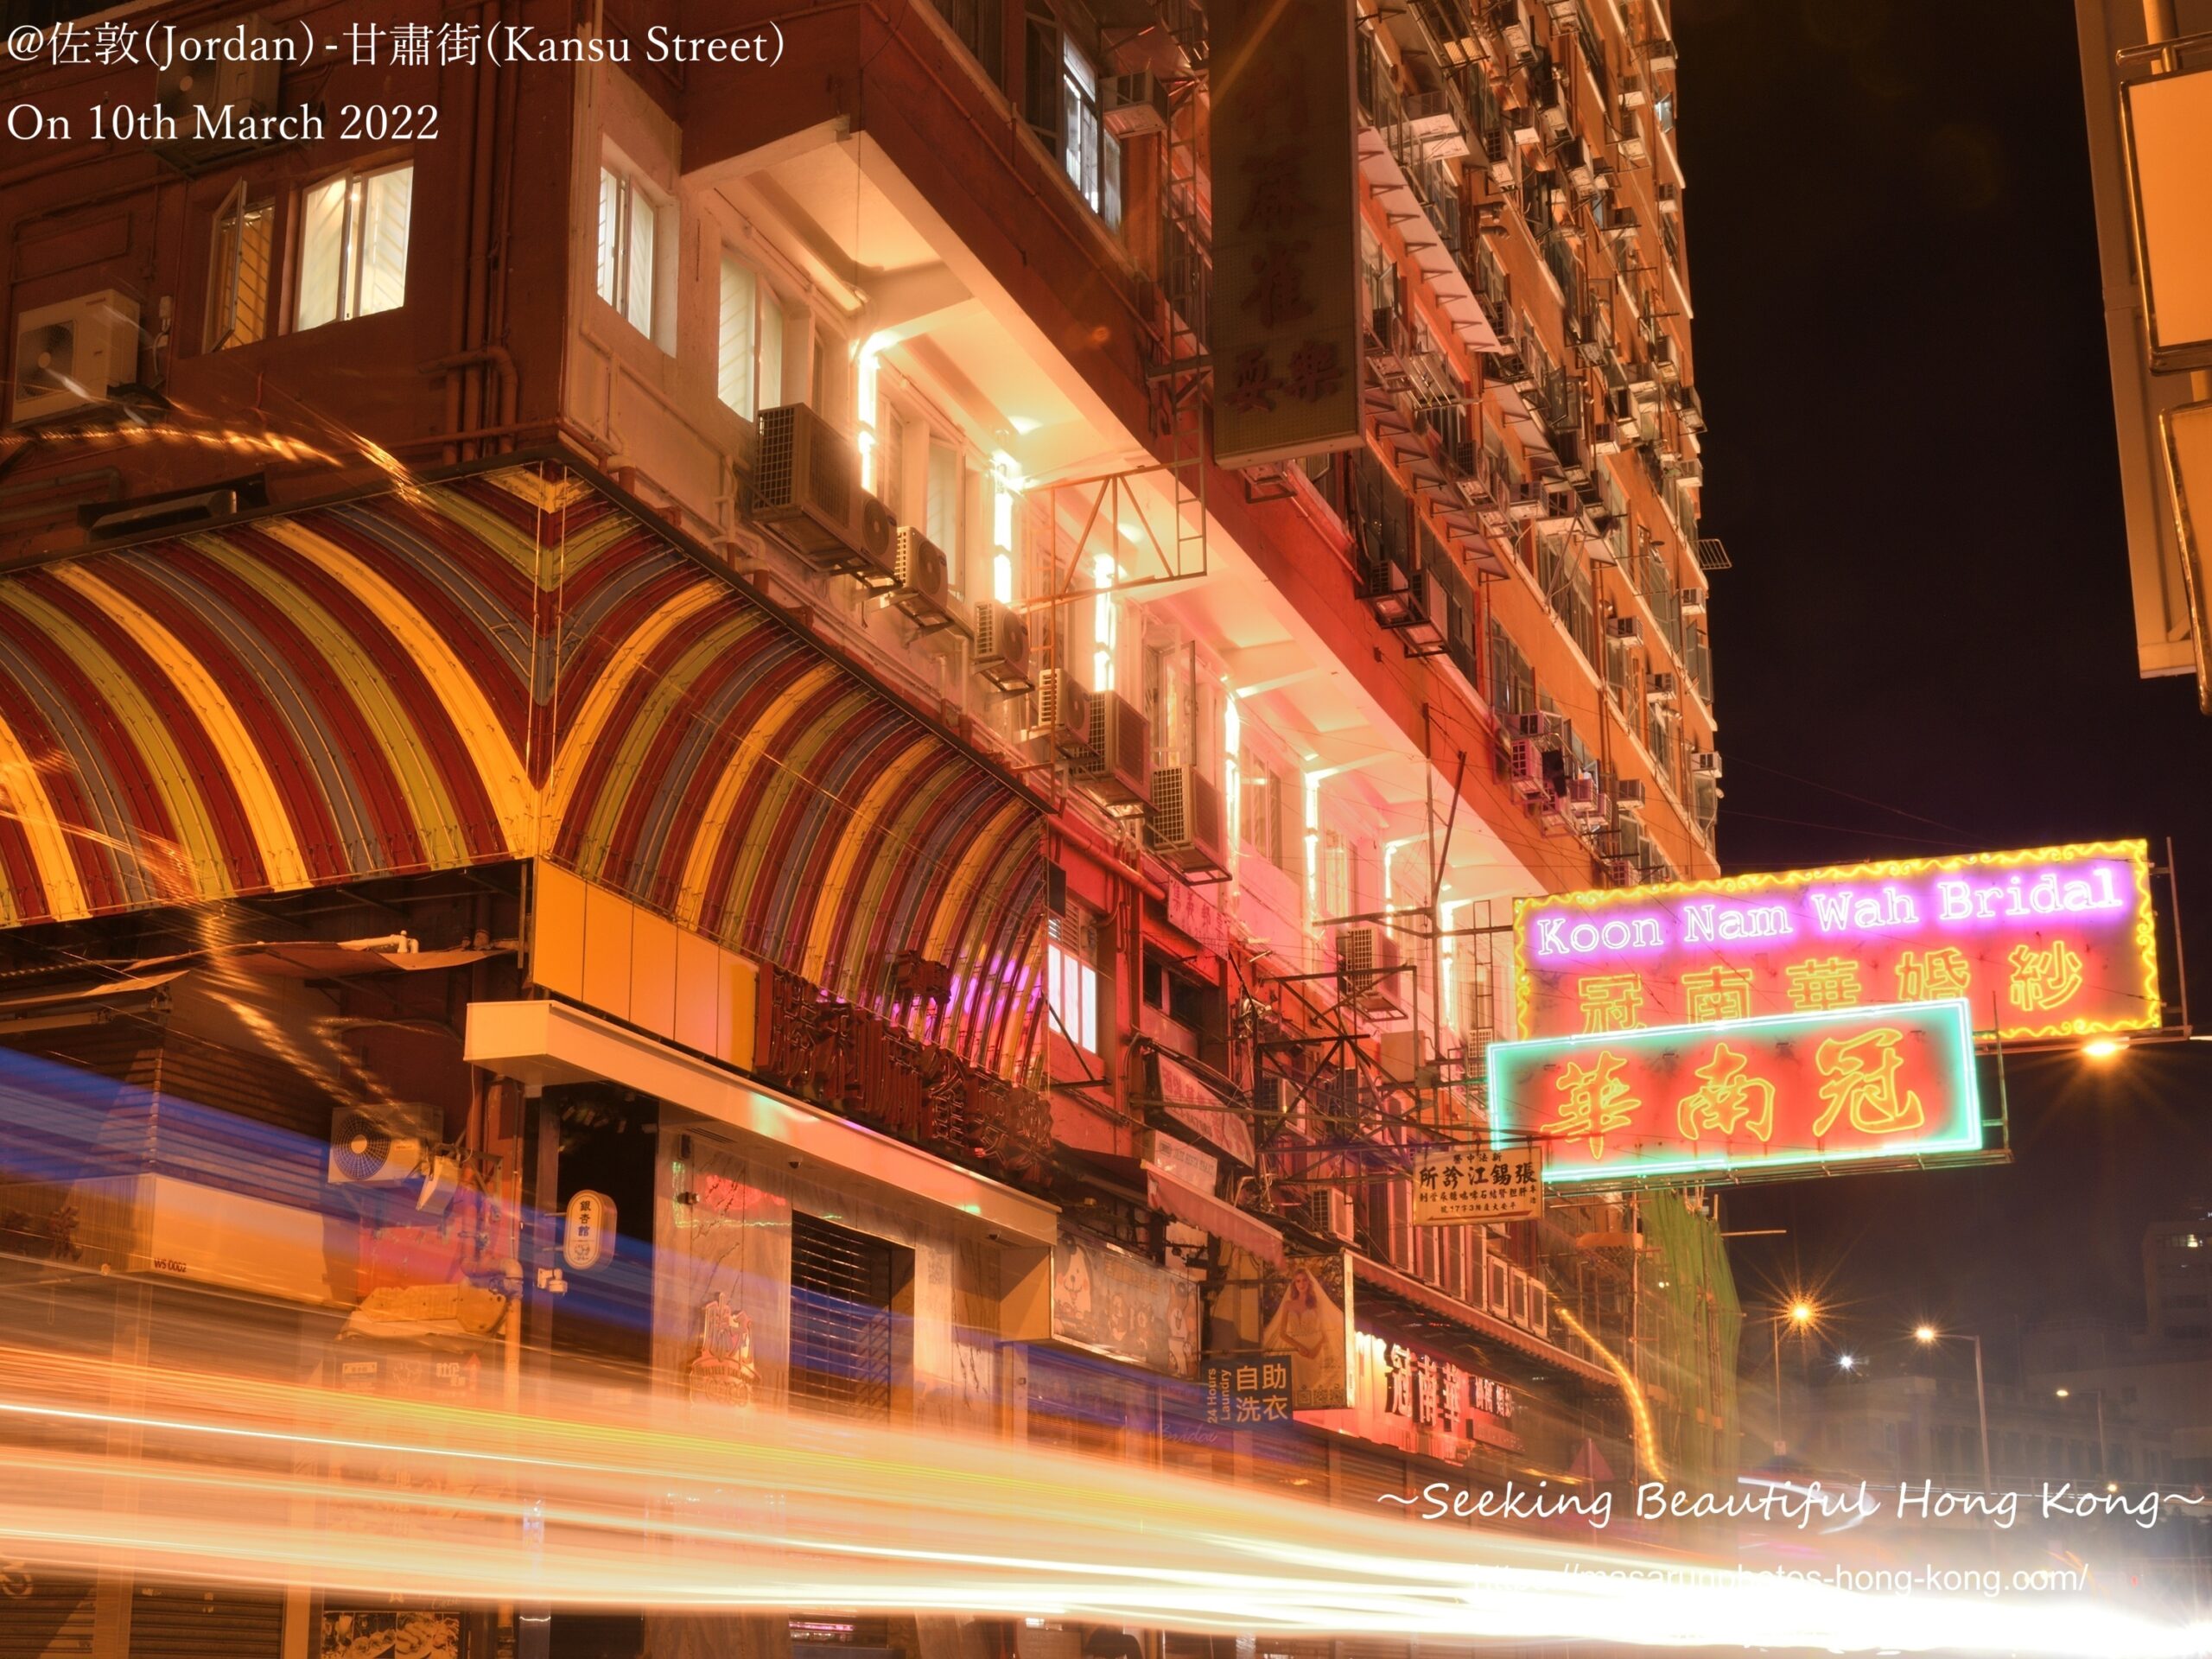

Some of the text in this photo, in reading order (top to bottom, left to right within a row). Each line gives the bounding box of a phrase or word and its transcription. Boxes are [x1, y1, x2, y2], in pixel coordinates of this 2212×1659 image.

[1536, 867, 2123, 956] Koon Nam Wah Bridal
[1418, 1162, 1538, 1190] 張錫江診所
[1206, 1368, 1218, 1424] 24 Hours
[1219, 1369, 1233, 1421] Laundry
[1236, 1363, 1287, 1391] 自助
[1236, 1395, 1289, 1423] 洗衣
